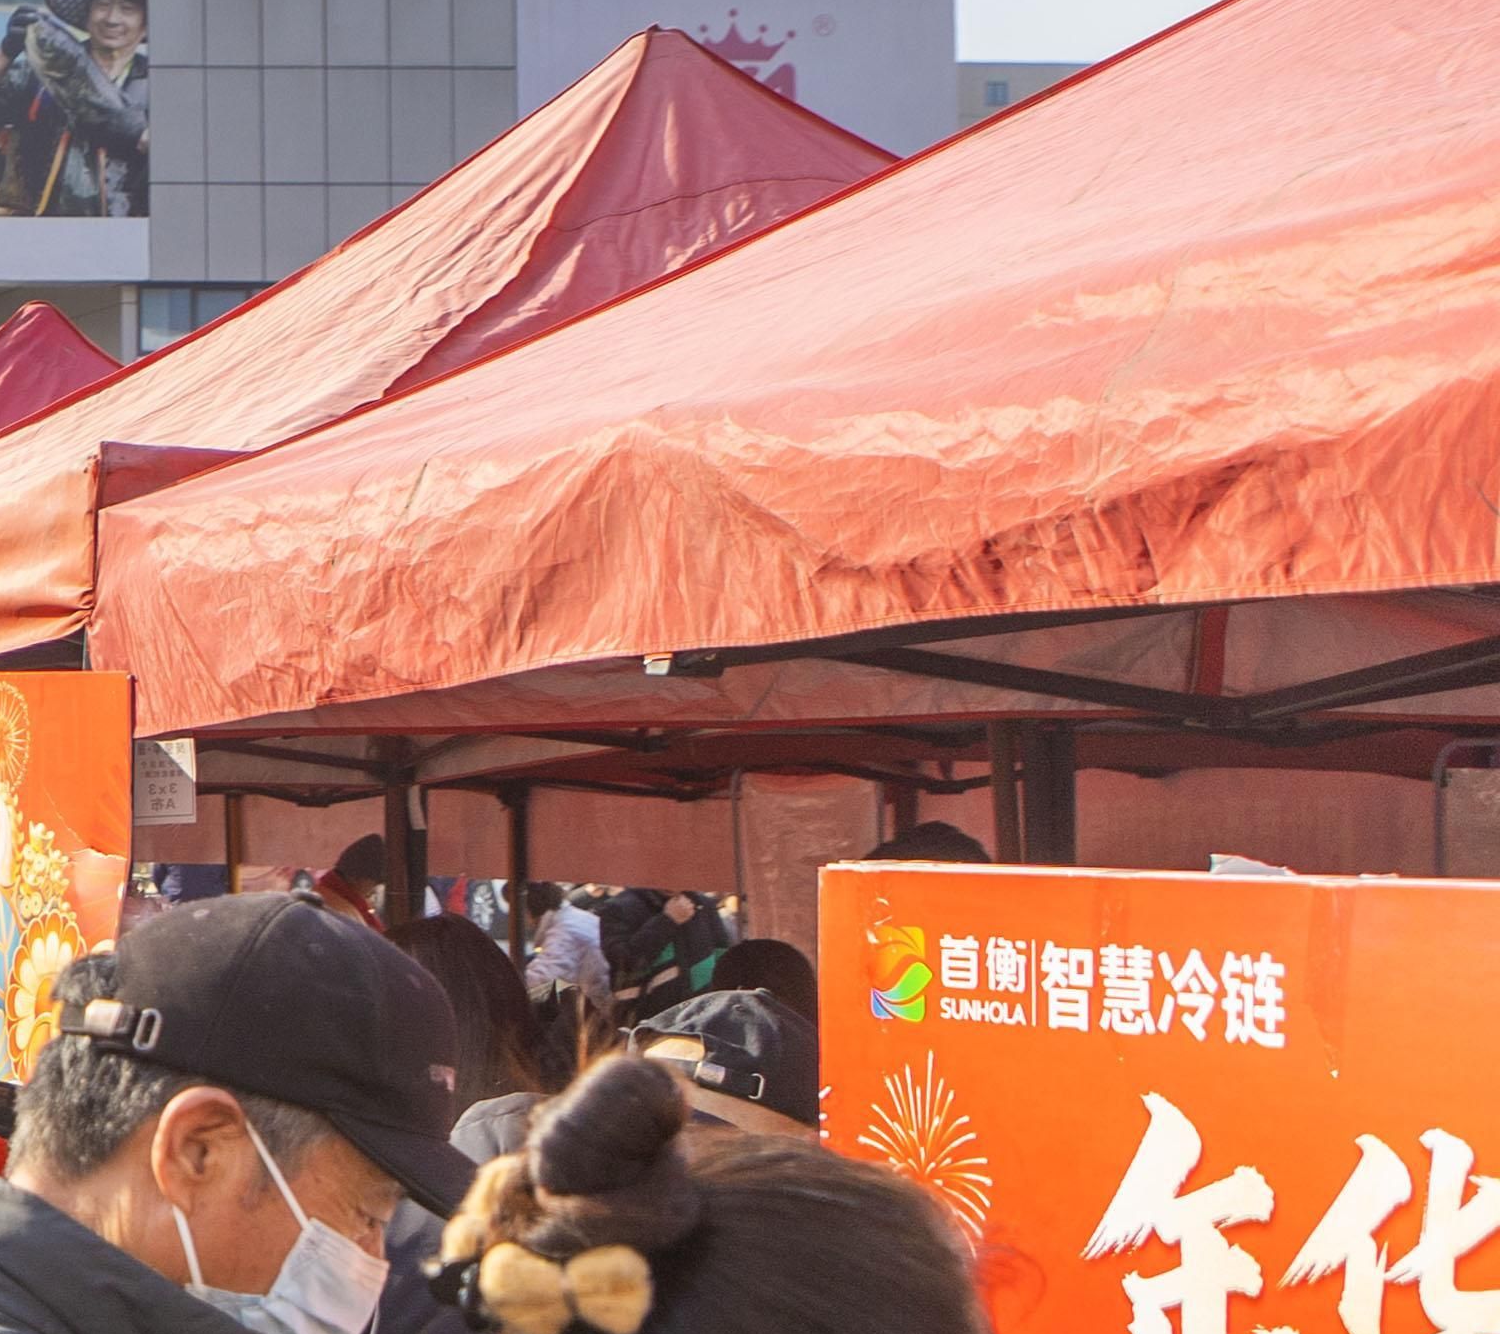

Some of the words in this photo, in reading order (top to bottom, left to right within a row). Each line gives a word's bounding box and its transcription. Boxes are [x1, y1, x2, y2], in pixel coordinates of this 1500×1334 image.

[939, 934, 1027, 993] 首衡
[1040, 940, 1286, 1049] 智慧冷链
[939, 996, 1027, 1027] SUNHOLA
